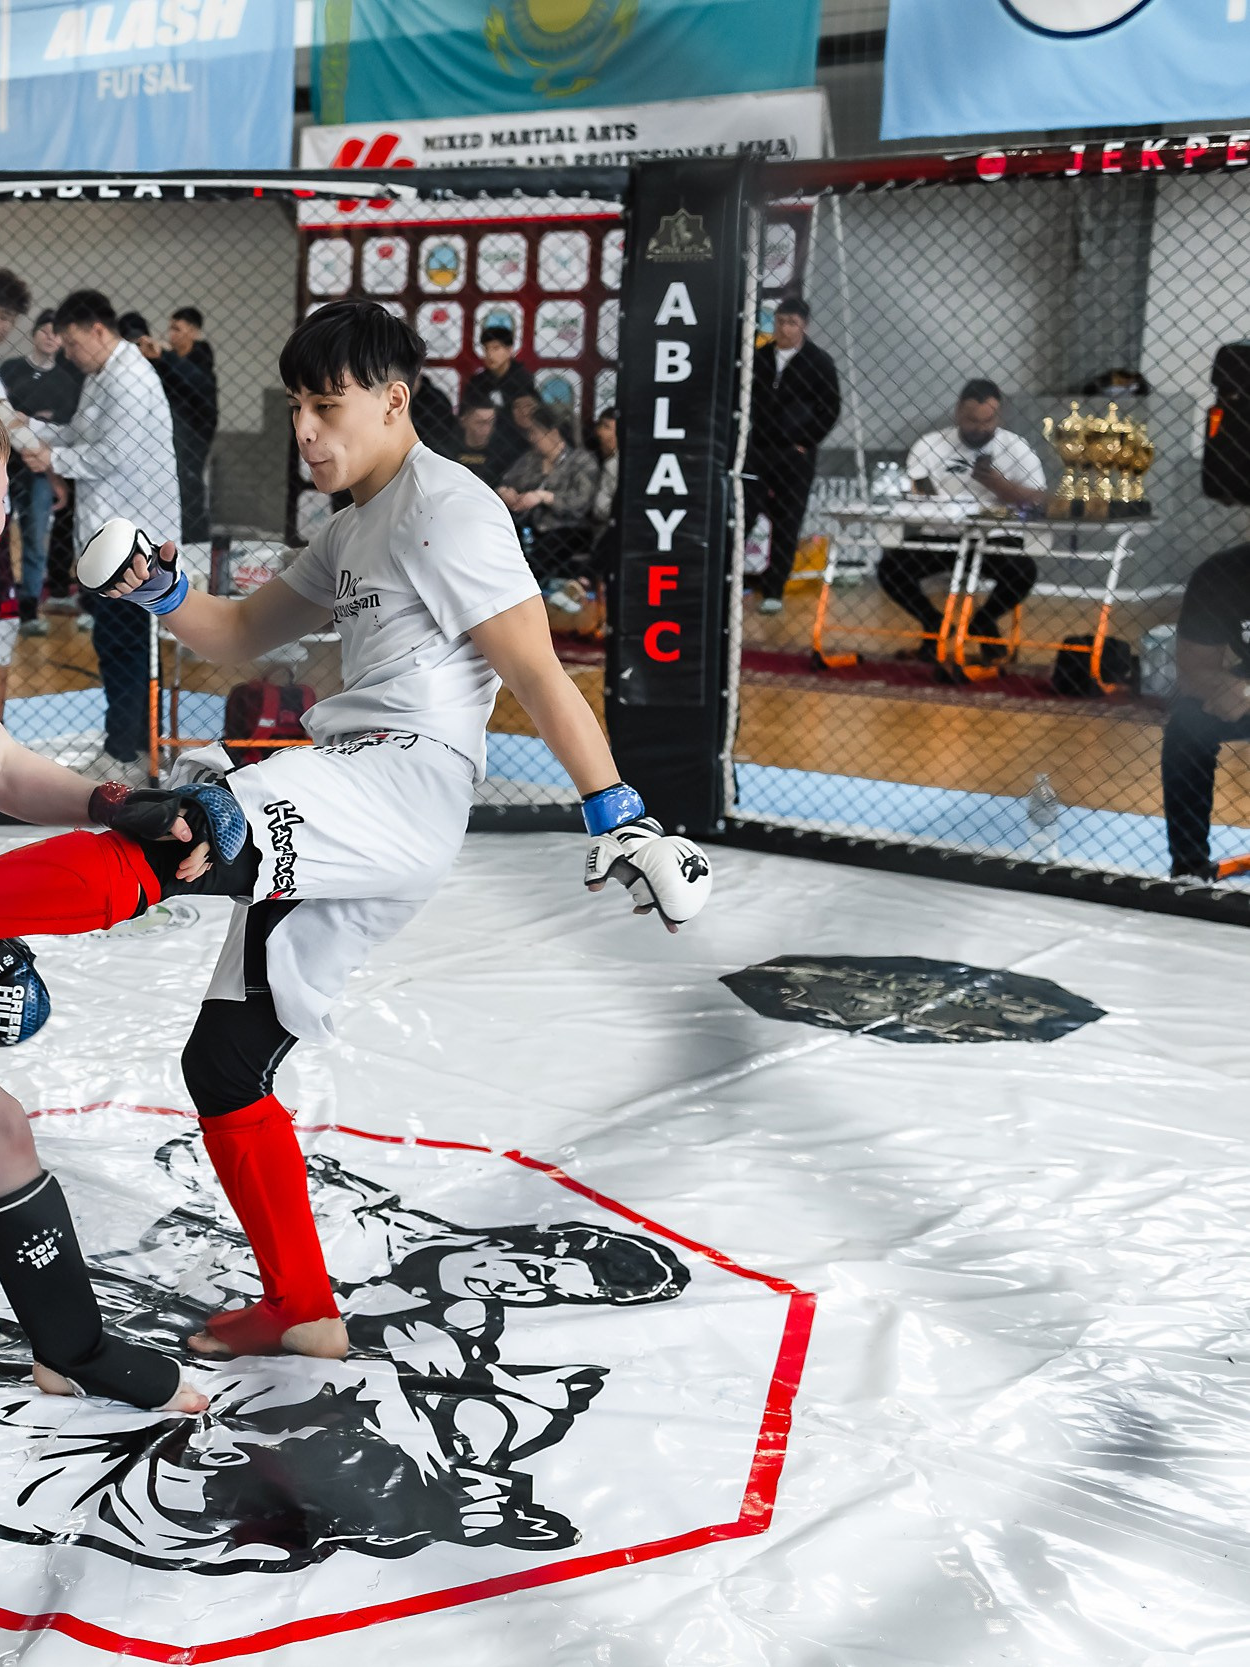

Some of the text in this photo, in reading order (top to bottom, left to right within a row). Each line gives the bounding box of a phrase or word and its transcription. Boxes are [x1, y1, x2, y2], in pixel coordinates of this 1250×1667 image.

[43, 0, 249, 61] ALASH
[97, 60, 194, 100] FUTSAL
[423, 122, 638, 151] MIXED MARTIAL ARTS
[1064, 133, 1250, 177] JEKPE
[645, 281, 698, 551] ABLAY
[643, 565, 681, 662] FC
[1, 985, 25, 1045] GREEN
[25, 1236, 55, 1261] TOP
[31, 1246, 60, 1270] TEN
